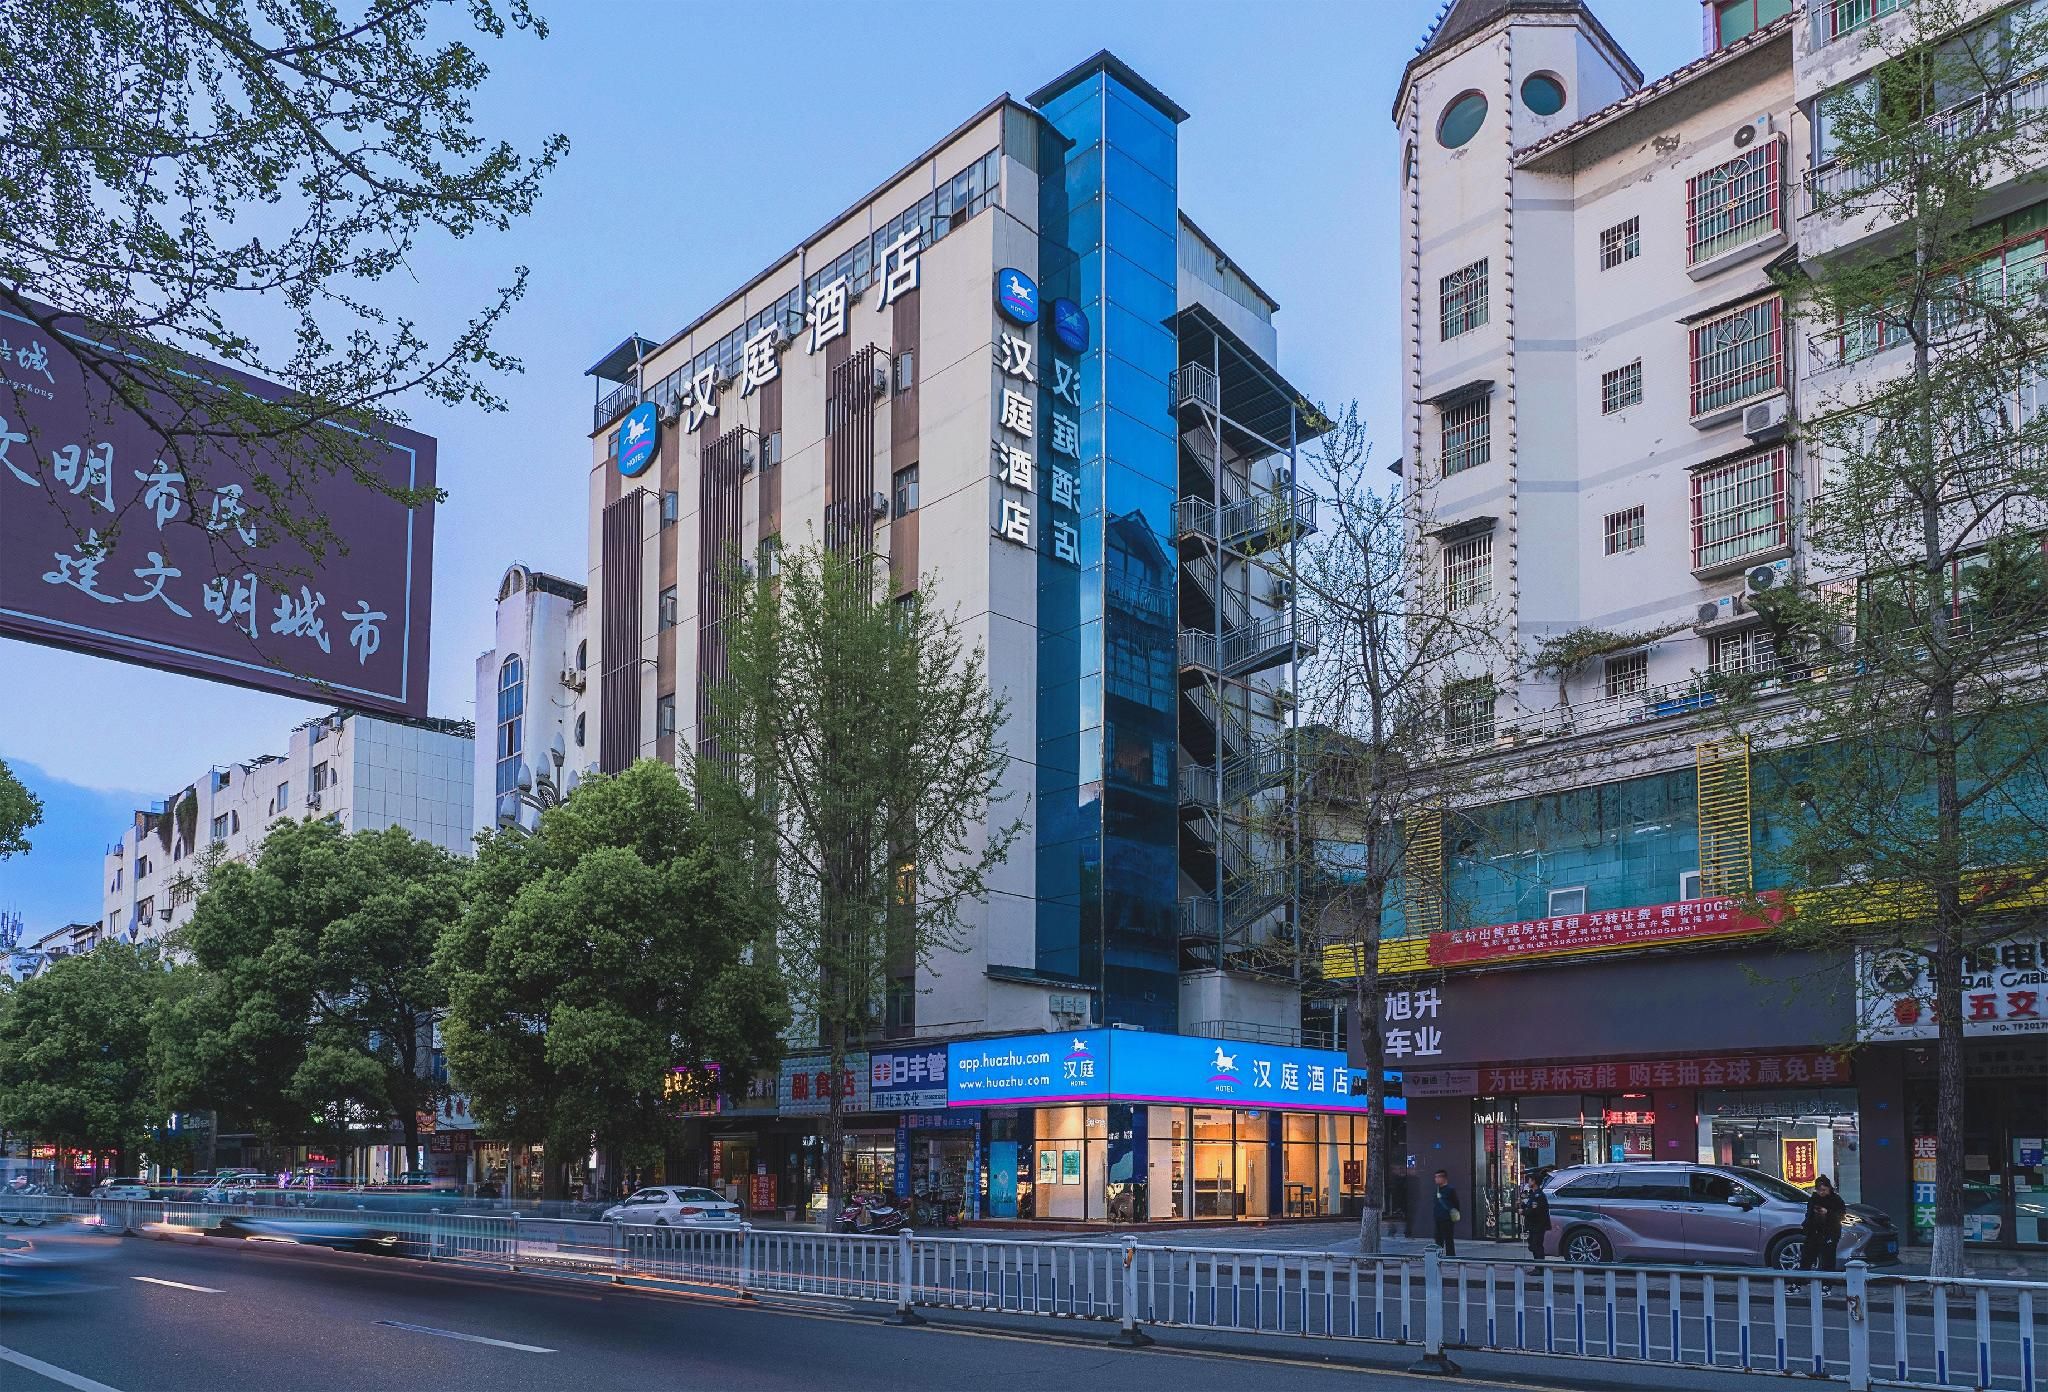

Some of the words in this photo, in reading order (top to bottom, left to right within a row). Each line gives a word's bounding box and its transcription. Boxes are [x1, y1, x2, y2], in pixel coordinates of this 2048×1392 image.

[1010, 305, 1028, 318] HOTEL
[682, 226, 922, 434] 汉庭酒店
[1000, 331, 1034, 545] 汉庭酒店
[626, 453, 645, 469] HOTEL
[42, 528, 387, 666] 建文明城市
[1385, 988, 1442, 1021] 旭升
[1992, 1024, 2010, 1032] NO.
[1385, 1026, 1442, 1058] 车业
[894, 1052, 947, 1083] 日丰管
[959, 1051, 1050, 1072] app.huazhu.com
[1063, 1060, 1095, 1079] 汉庭
[959, 1075, 1050, 1090] www.huazhu.com
[1215, 1085, 1235, 1093] HOTEL
[1253, 1060, 1348, 1095] 汉庭酒店
